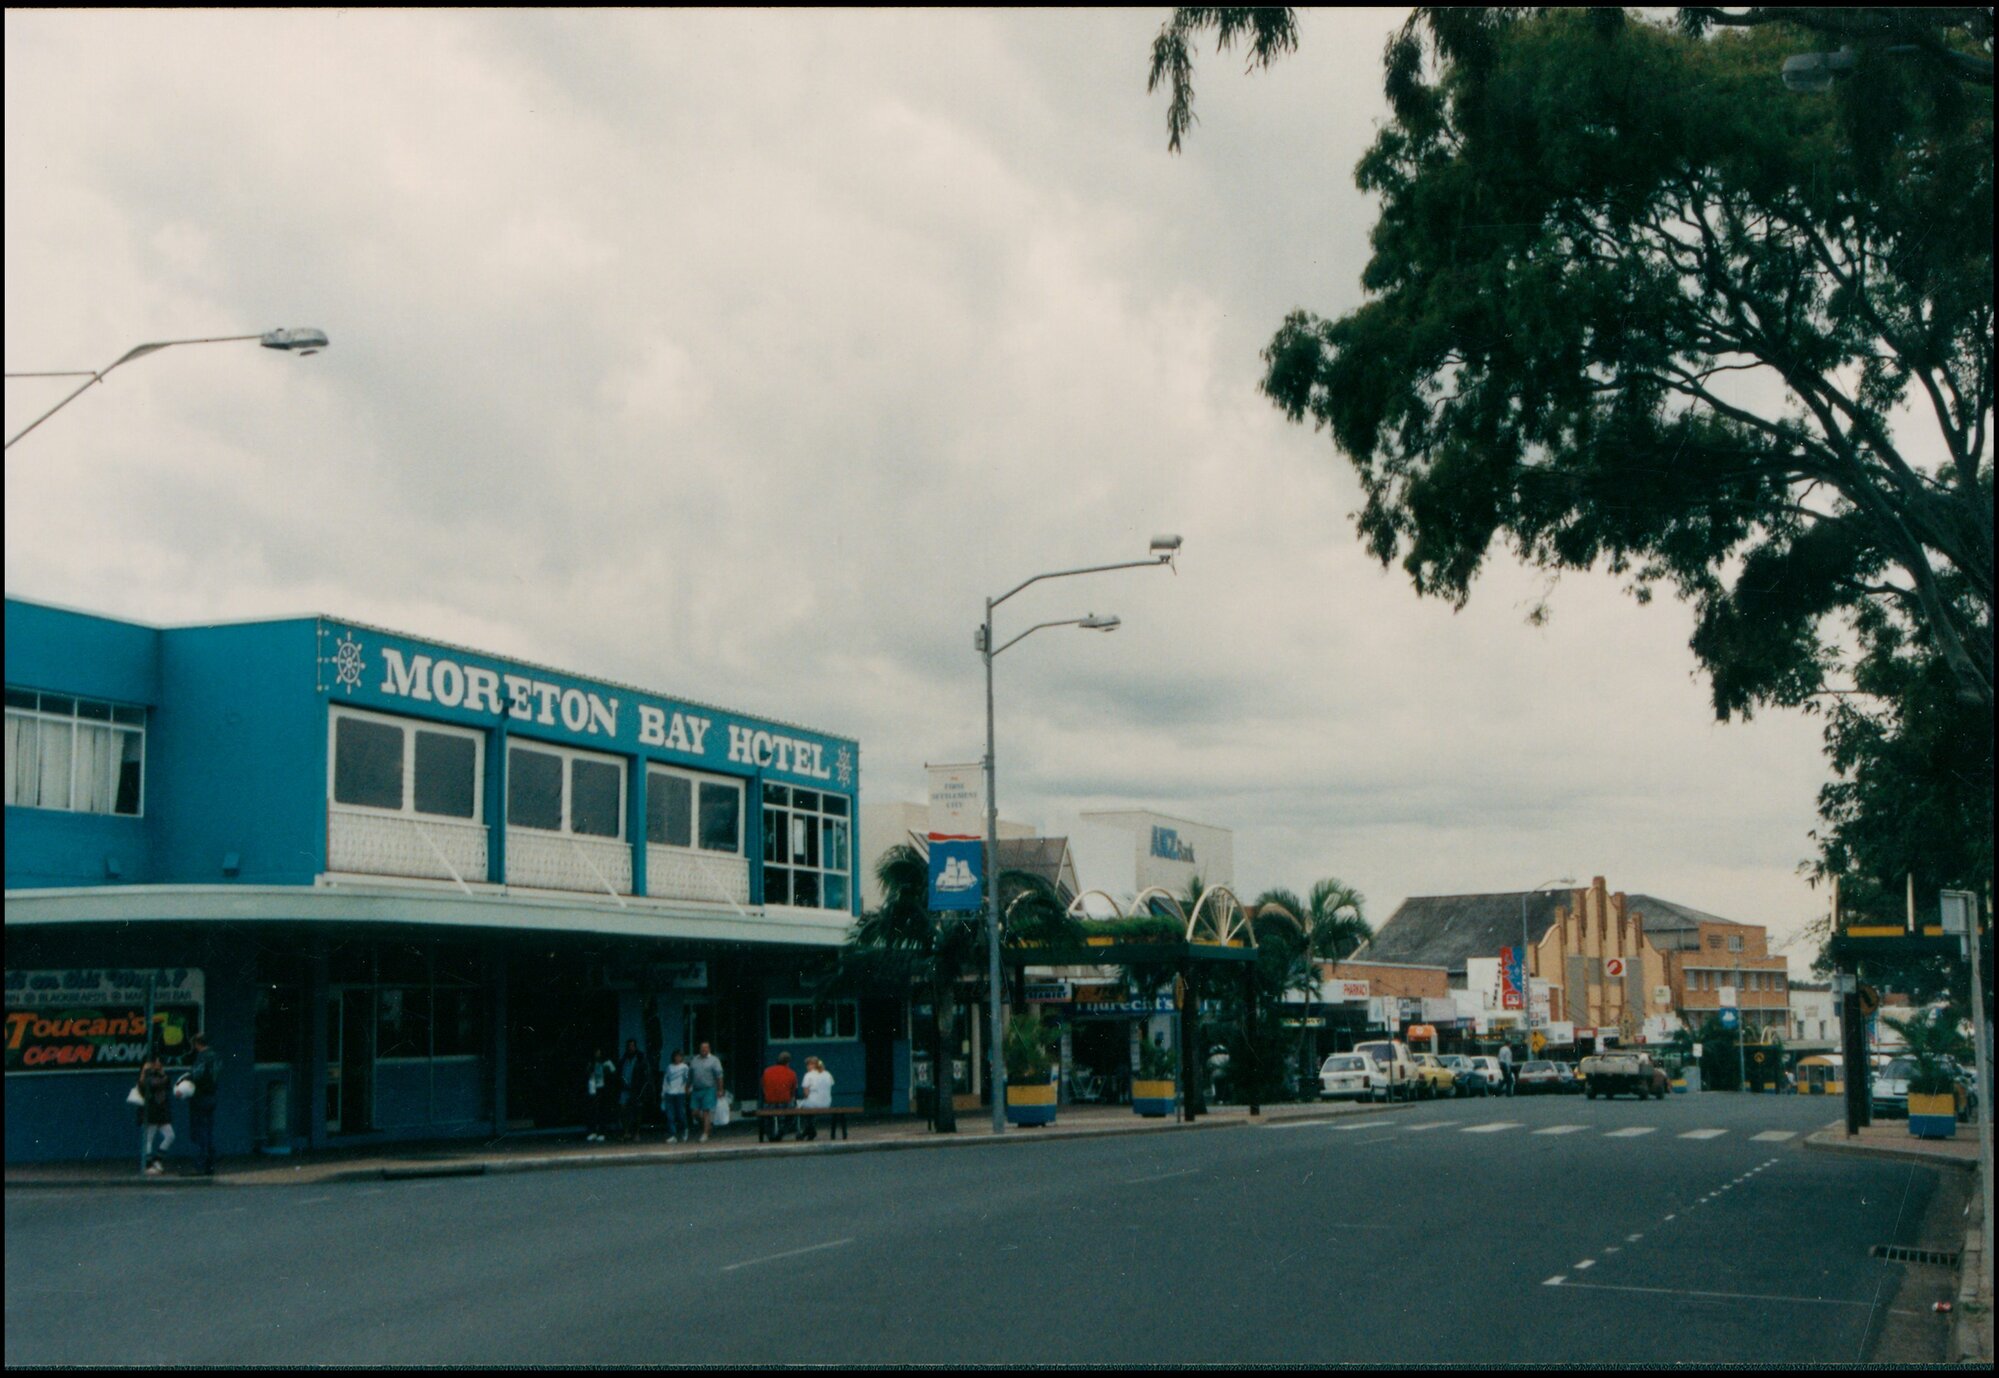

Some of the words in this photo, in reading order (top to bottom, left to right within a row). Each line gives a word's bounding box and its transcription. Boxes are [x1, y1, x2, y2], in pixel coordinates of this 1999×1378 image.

[381, 647, 619, 738] MORETON
[638, 704, 711, 755] BAY
[728, 724, 831, 780] HOTEL
[22, 1043, 96, 1066] OPEN
[96, 1042, 149, 1063] NOW
